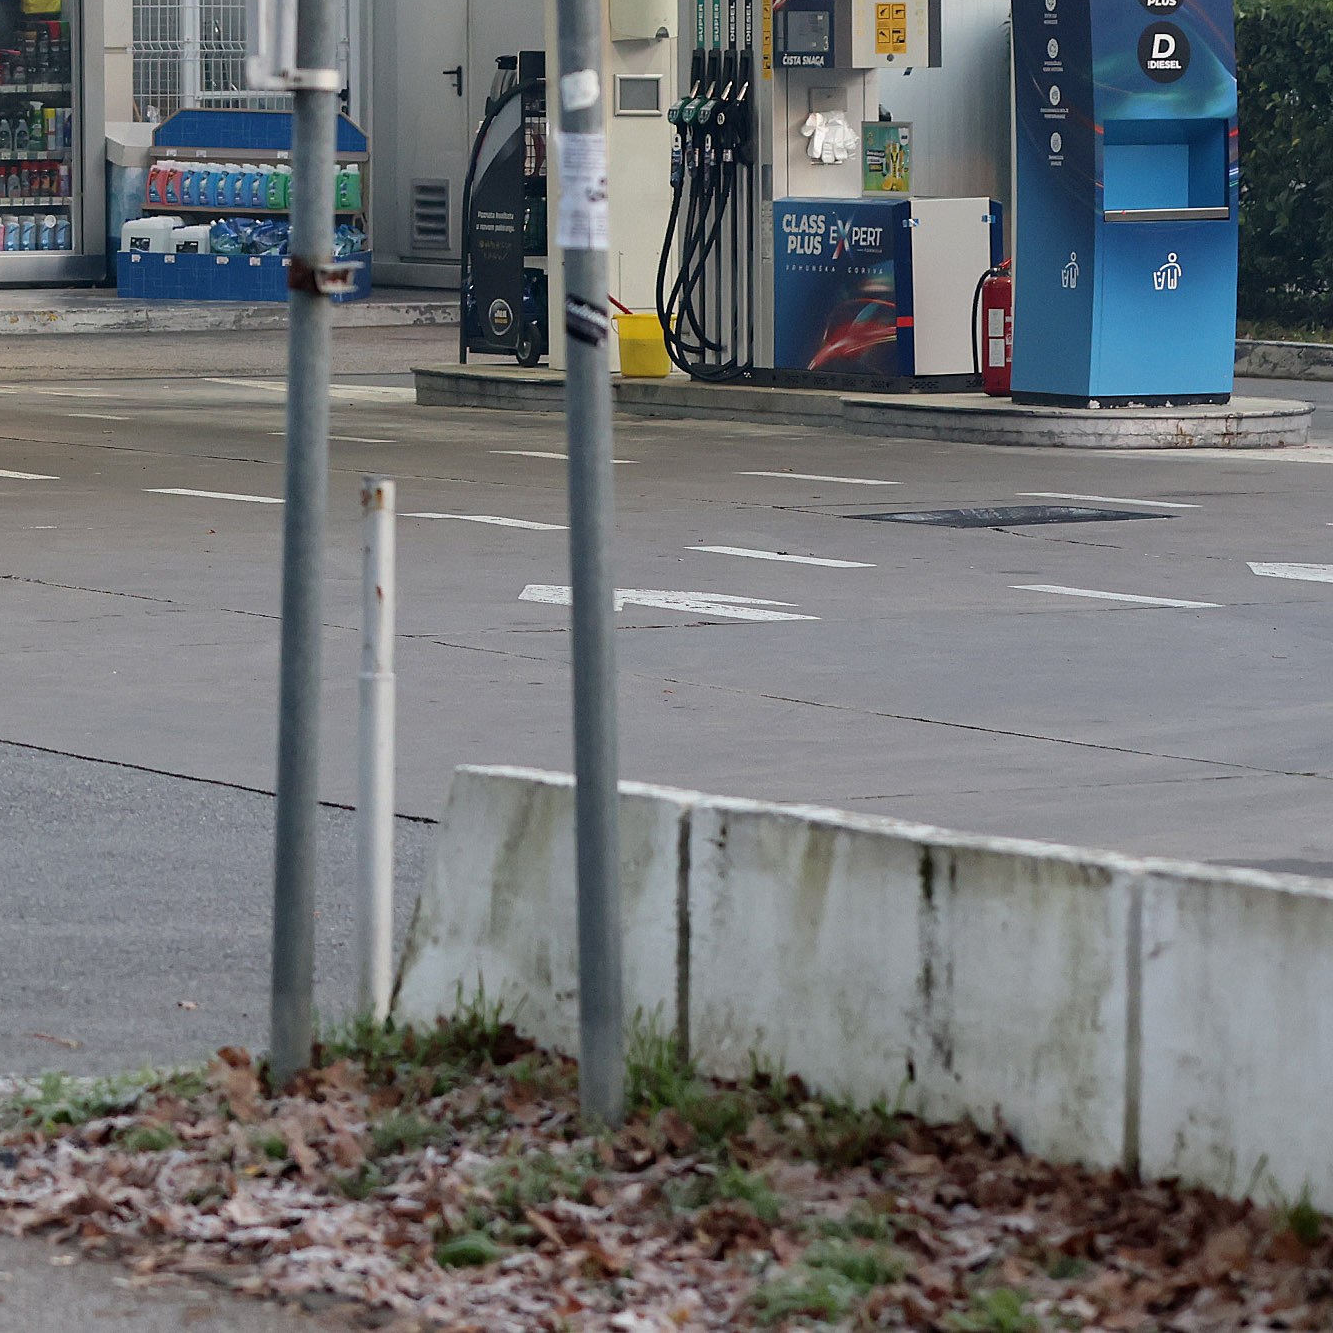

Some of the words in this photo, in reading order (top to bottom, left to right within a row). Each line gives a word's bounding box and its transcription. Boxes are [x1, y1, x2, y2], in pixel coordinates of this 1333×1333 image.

[1151, 33, 1175, 59] D
[782, 53, 801, 66] ČISTA
[802, 55, 825, 66] SNAGA
[782, 213, 826, 234] CLASS
[787, 235, 822, 255] PLUS
[829, 219, 883, 259] EXPERT
